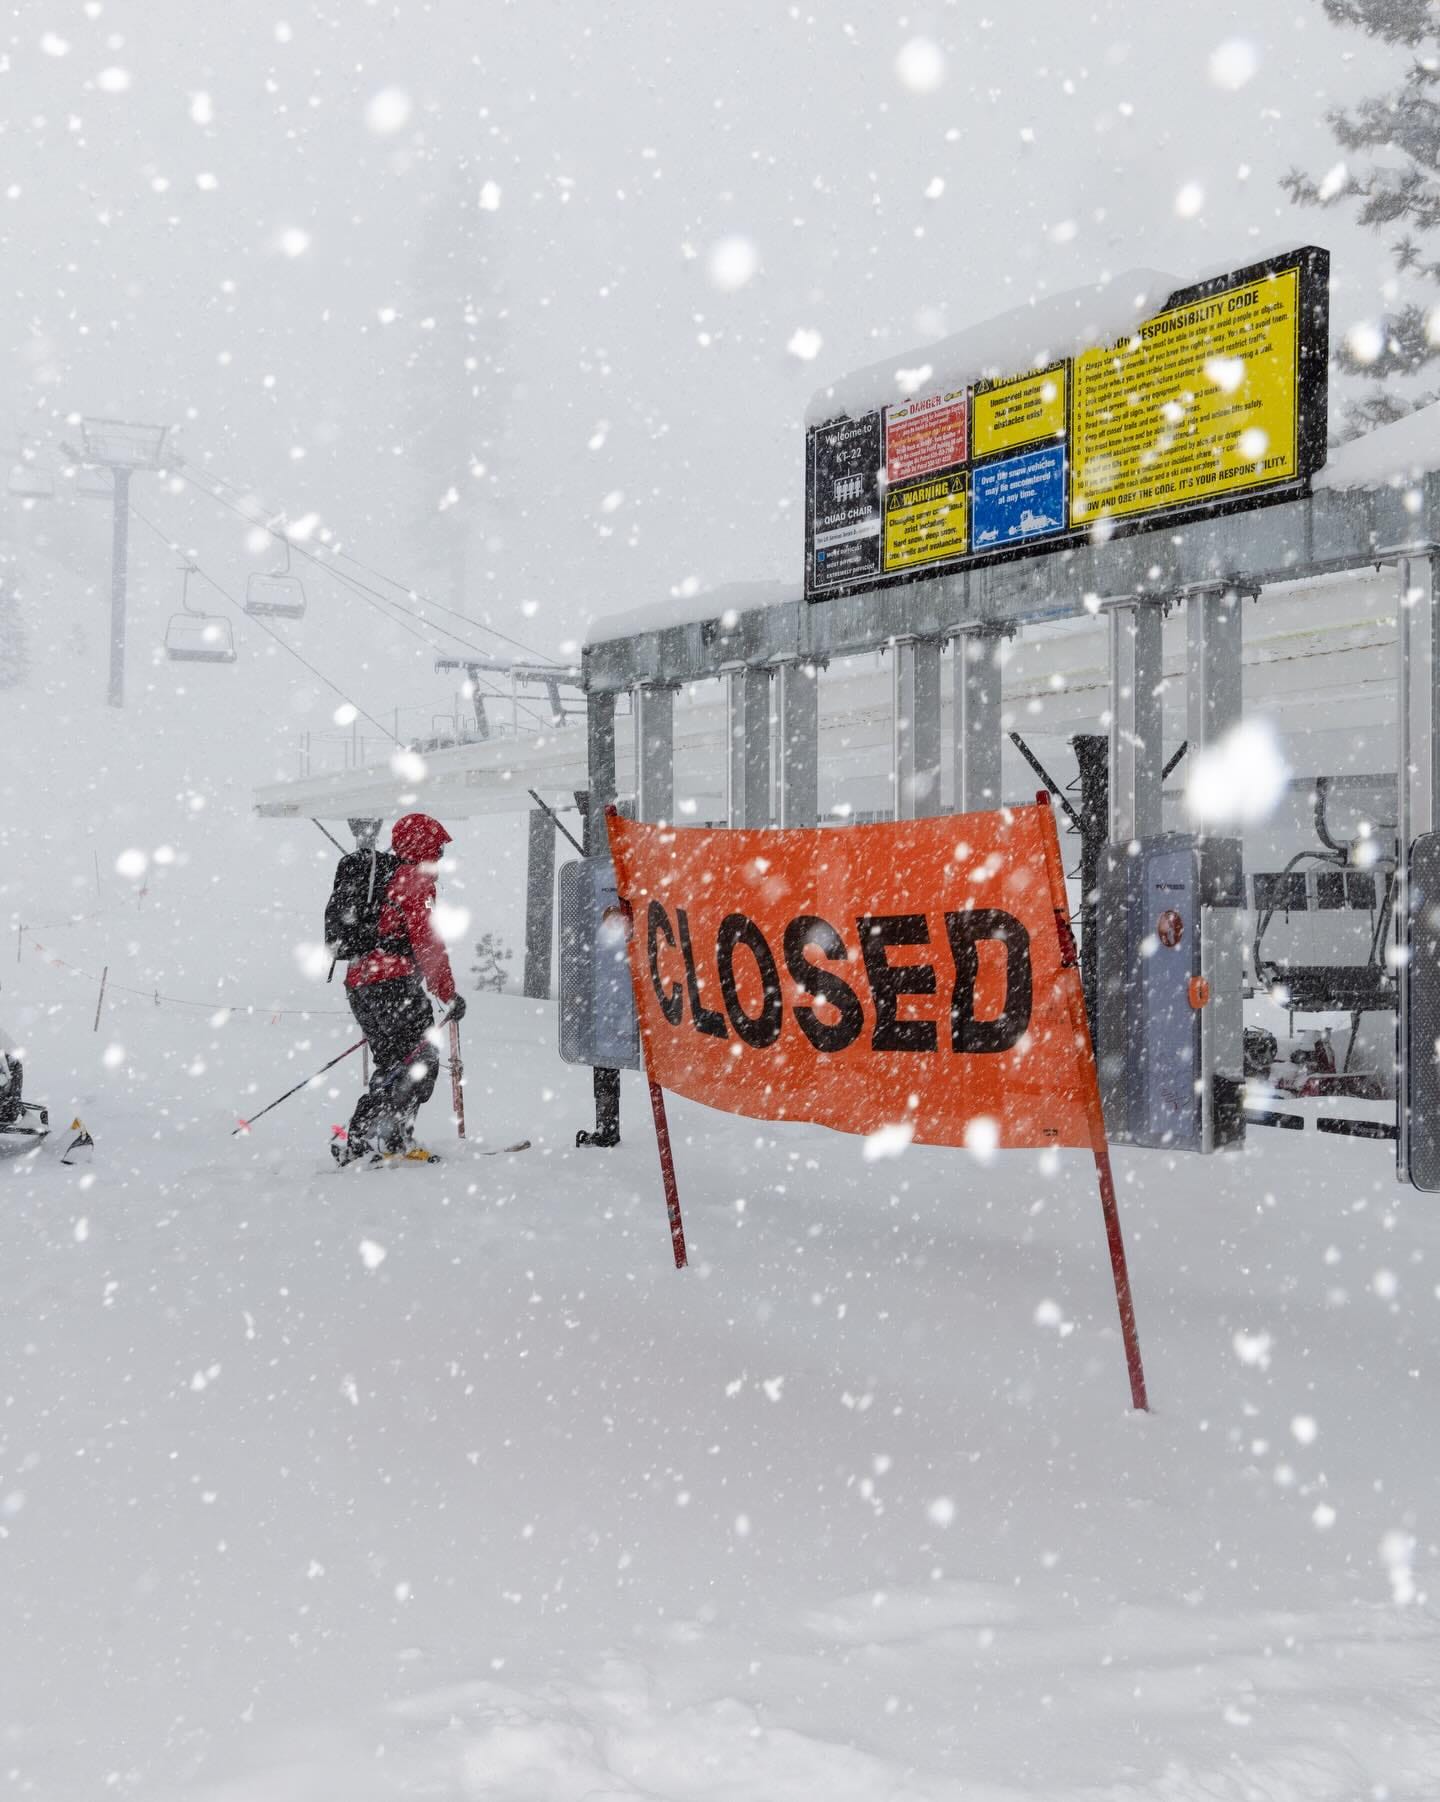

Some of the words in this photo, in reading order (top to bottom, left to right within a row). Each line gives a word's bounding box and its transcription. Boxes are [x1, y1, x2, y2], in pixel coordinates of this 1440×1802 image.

[1138, 304, 1223, 341] ESPONSIBILITY
[1228, 290, 1258, 312] CODE
[909, 396, 941, 414] DANGER
[993, 414, 1024, 430] obstacles
[825, 425, 861, 445] Welcome
[863, 423, 871, 433] to
[836, 446, 861, 463] KT-22
[981, 474, 994, 485] Over
[1008, 467, 1026, 477] snow
[1027, 457, 1055, 473] vehicles
[1195, 472, 1216, 485] YOUR
[1218, 454, 1286, 479] RESPONSILITY.
[903, 482, 948, 505] WARNING
[985, 486, 998, 497] may
[1009, 471, 1050, 490] encountered
[998, 495, 1004, 504] at
[1006, 494, 1018, 503] any
[1020, 487, 1036, 499] time.
[824, 512, 845, 525] QUAD
[847, 505, 871, 519] CHAIR
[648, 900, 1033, 1054] CLOSED
